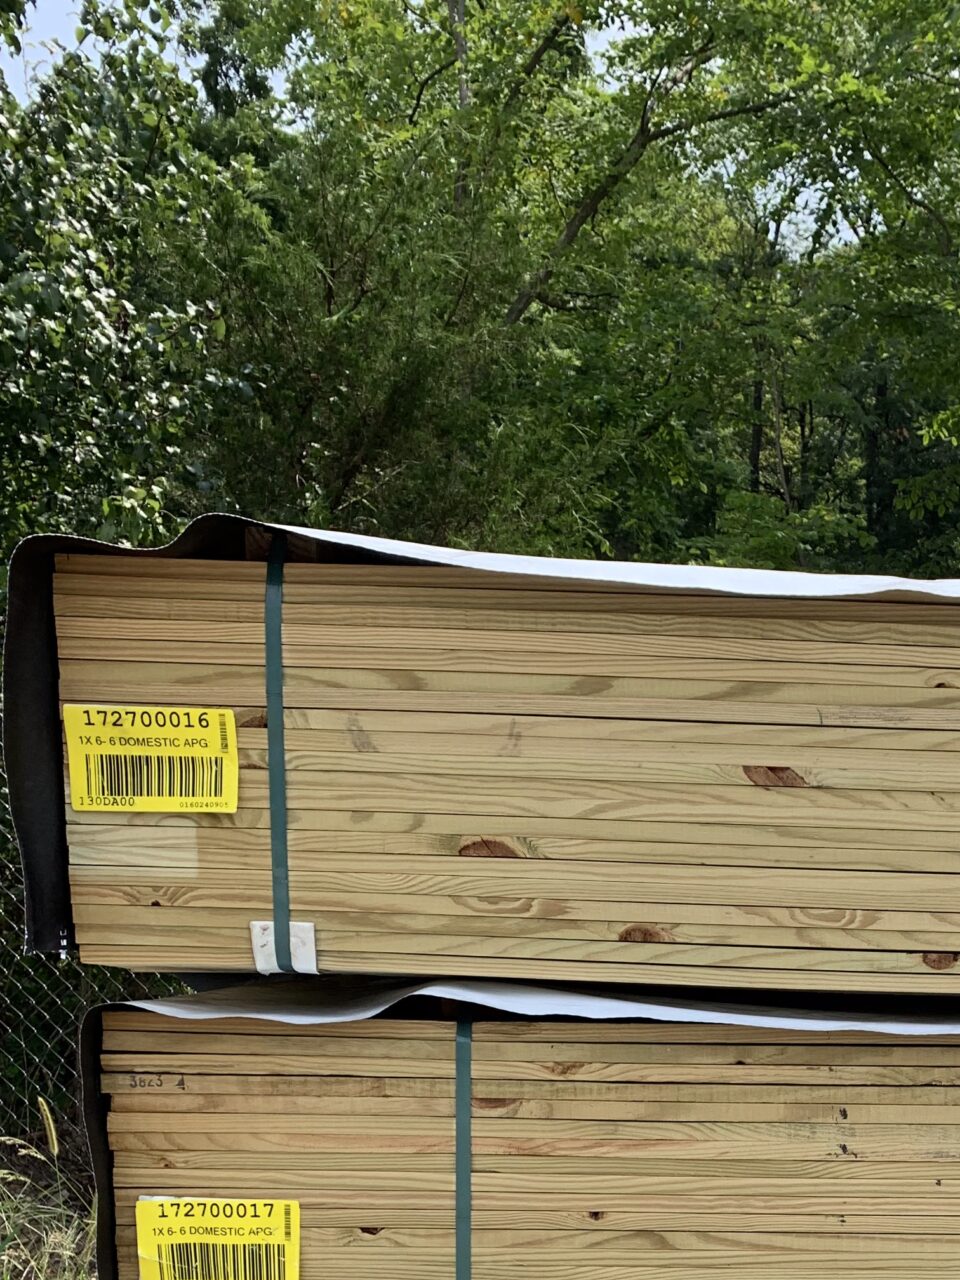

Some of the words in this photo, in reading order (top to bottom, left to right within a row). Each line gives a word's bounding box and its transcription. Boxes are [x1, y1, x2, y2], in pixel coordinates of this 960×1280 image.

[83, 710, 210, 728] 172700016
[79, 736, 92, 746] 1X
[118, 737, 180, 748] DOMESTIC
[184, 738, 208, 748] APG
[79, 796, 136, 807] 130DA00
[158, 1203, 274, 1218] 172700017
[152, 1227, 164, 1237] 1X
[190, 1226, 245, 1236] DOMESTIC
